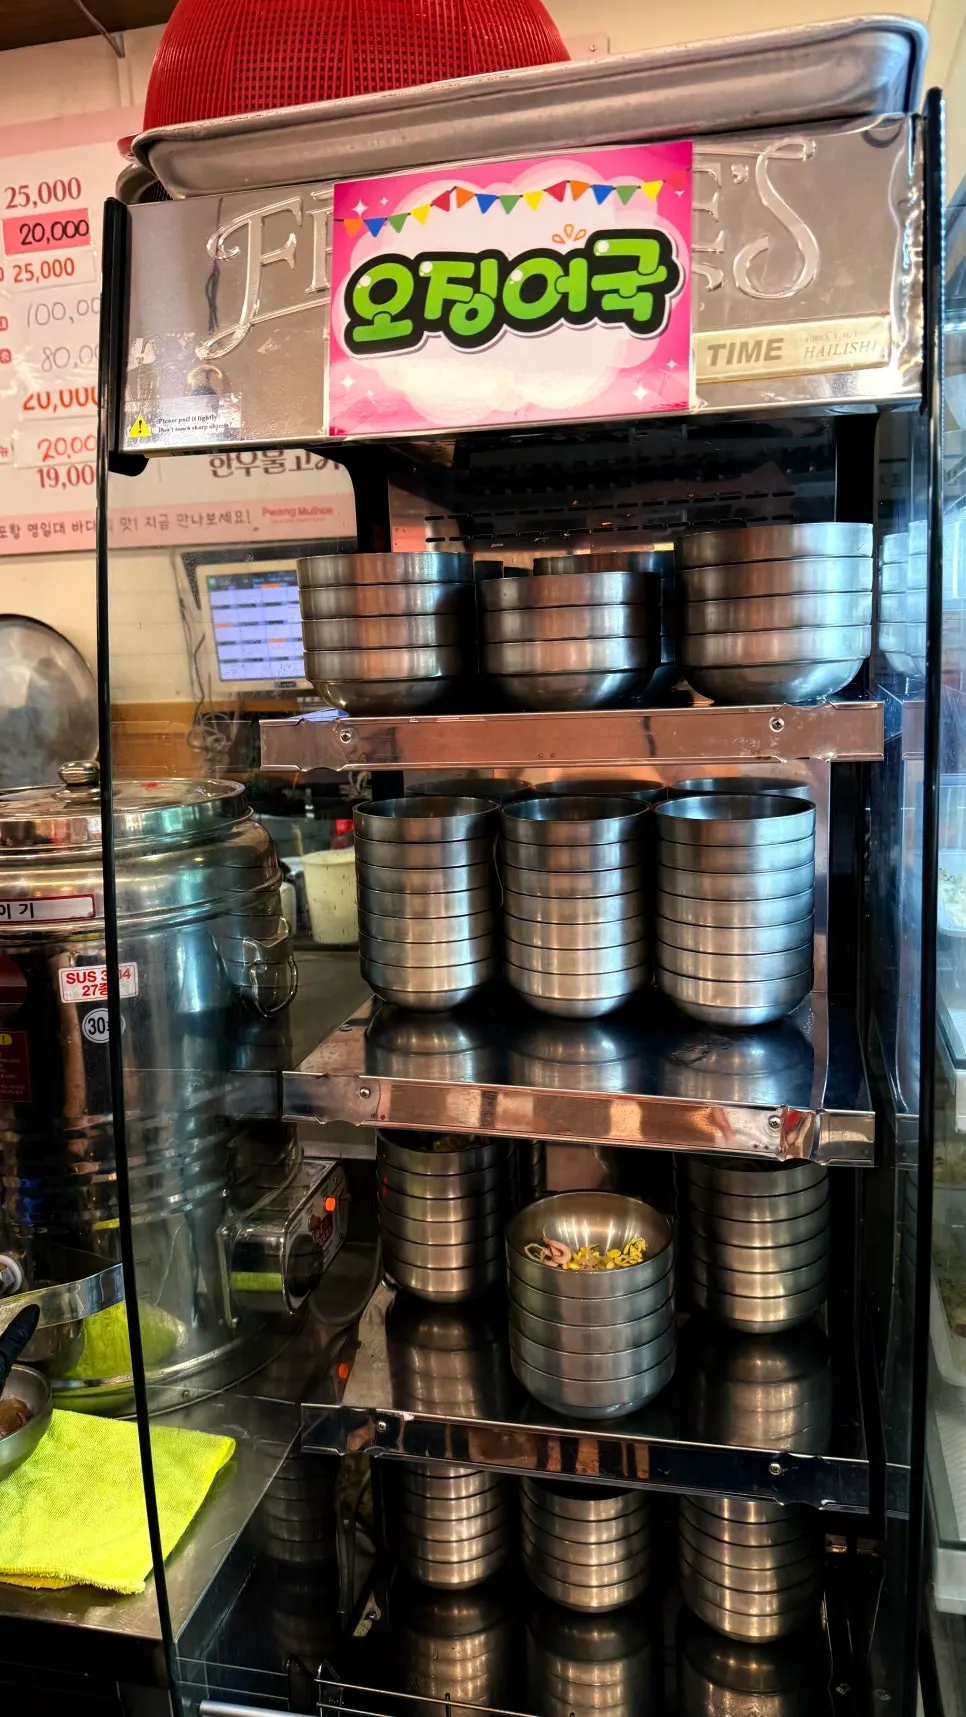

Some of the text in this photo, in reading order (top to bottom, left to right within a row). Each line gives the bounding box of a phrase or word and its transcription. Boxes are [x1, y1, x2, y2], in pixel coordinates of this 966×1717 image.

[4, 176, 82, 209] 25,000
[19, 219, 90, 246] 20,000
[13, 257, 75, 284] 25,000
[347, 232, 676, 350] 오징어국
[27, 297, 101, 328] 100,00
[706, 337, 785, 367] TIME
[38, 434, 96, 462] 20,00
[36, 463, 95, 491] 19,00
[144, 512, 170, 532] 지금
[66, 970, 97, 985] SUS
